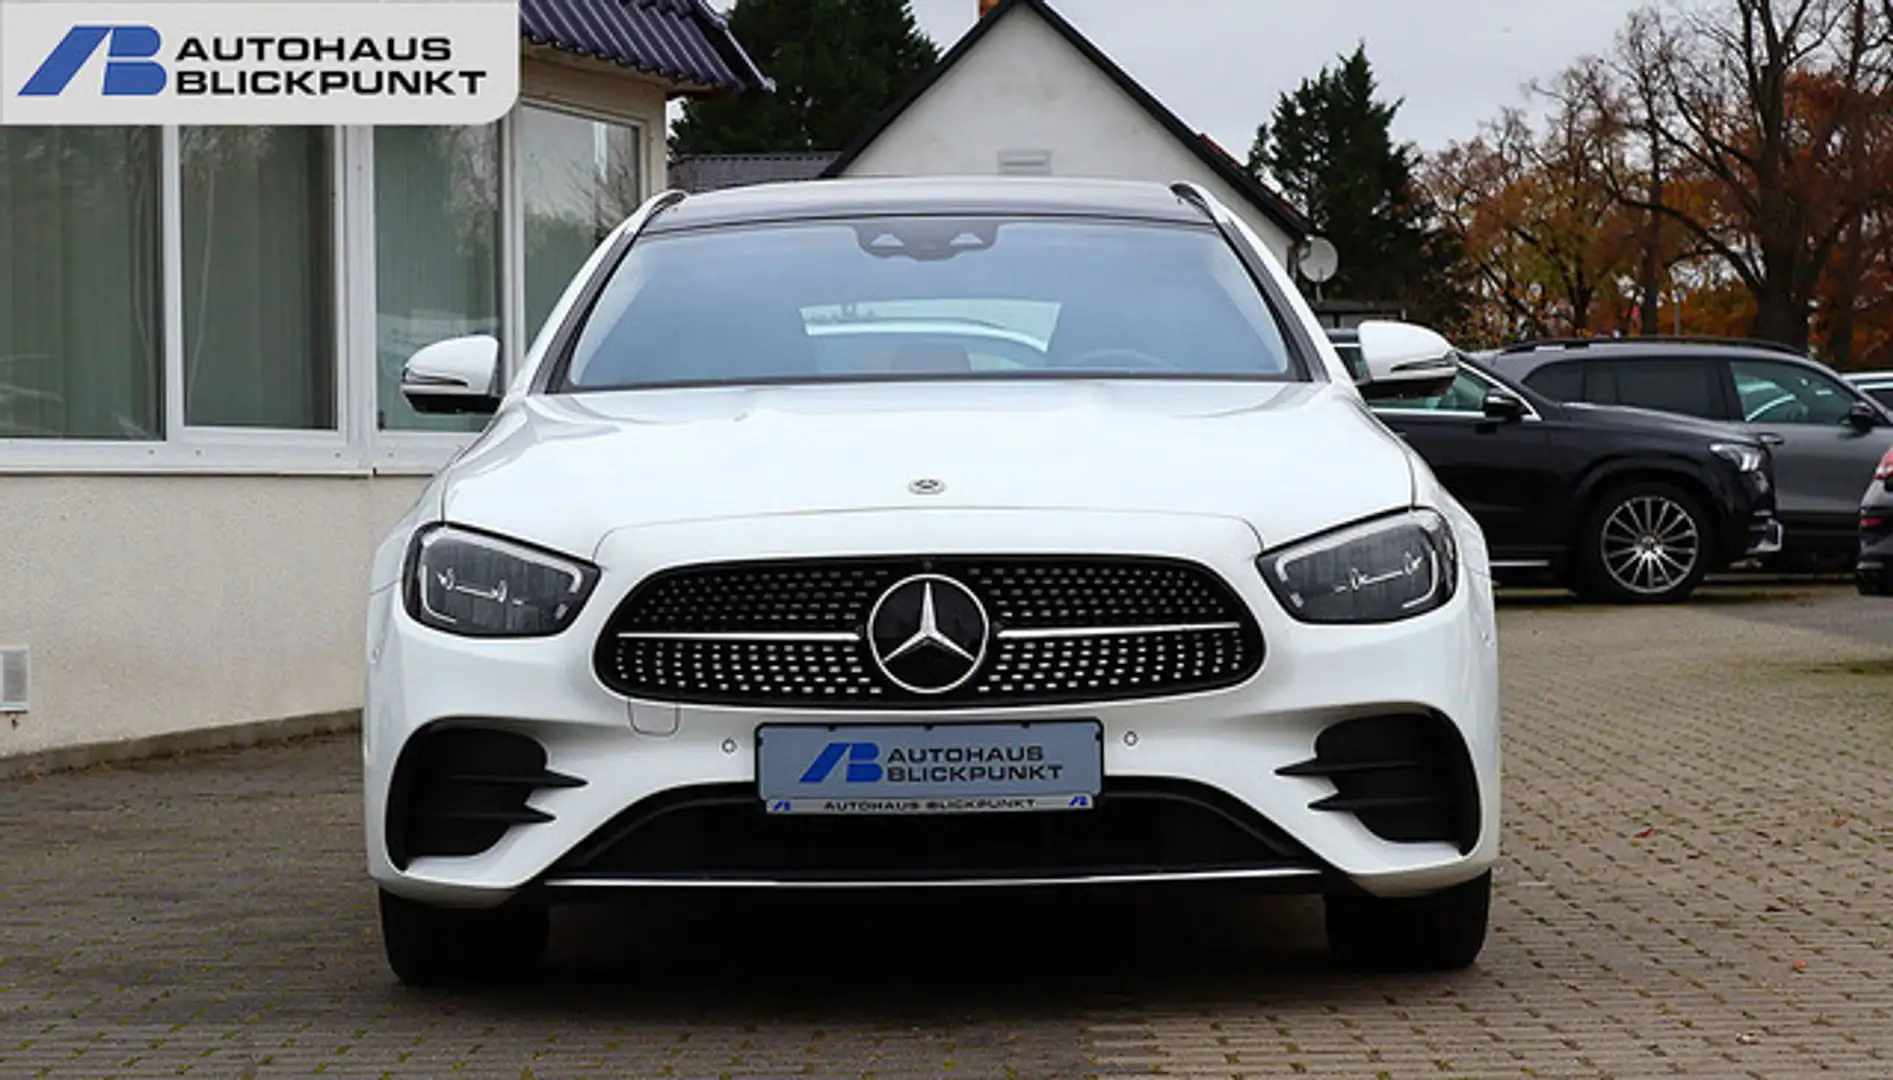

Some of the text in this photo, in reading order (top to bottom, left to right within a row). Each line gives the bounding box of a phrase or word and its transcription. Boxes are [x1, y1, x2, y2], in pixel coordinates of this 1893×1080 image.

[887, 745, 1045, 763] AUTOHAUS
[887, 765, 1063, 783] BLICKPUNKT
[824, 801, 922, 811] AUTOHAUS
[927, 799, 1036, 809] BLICKPUNKT
